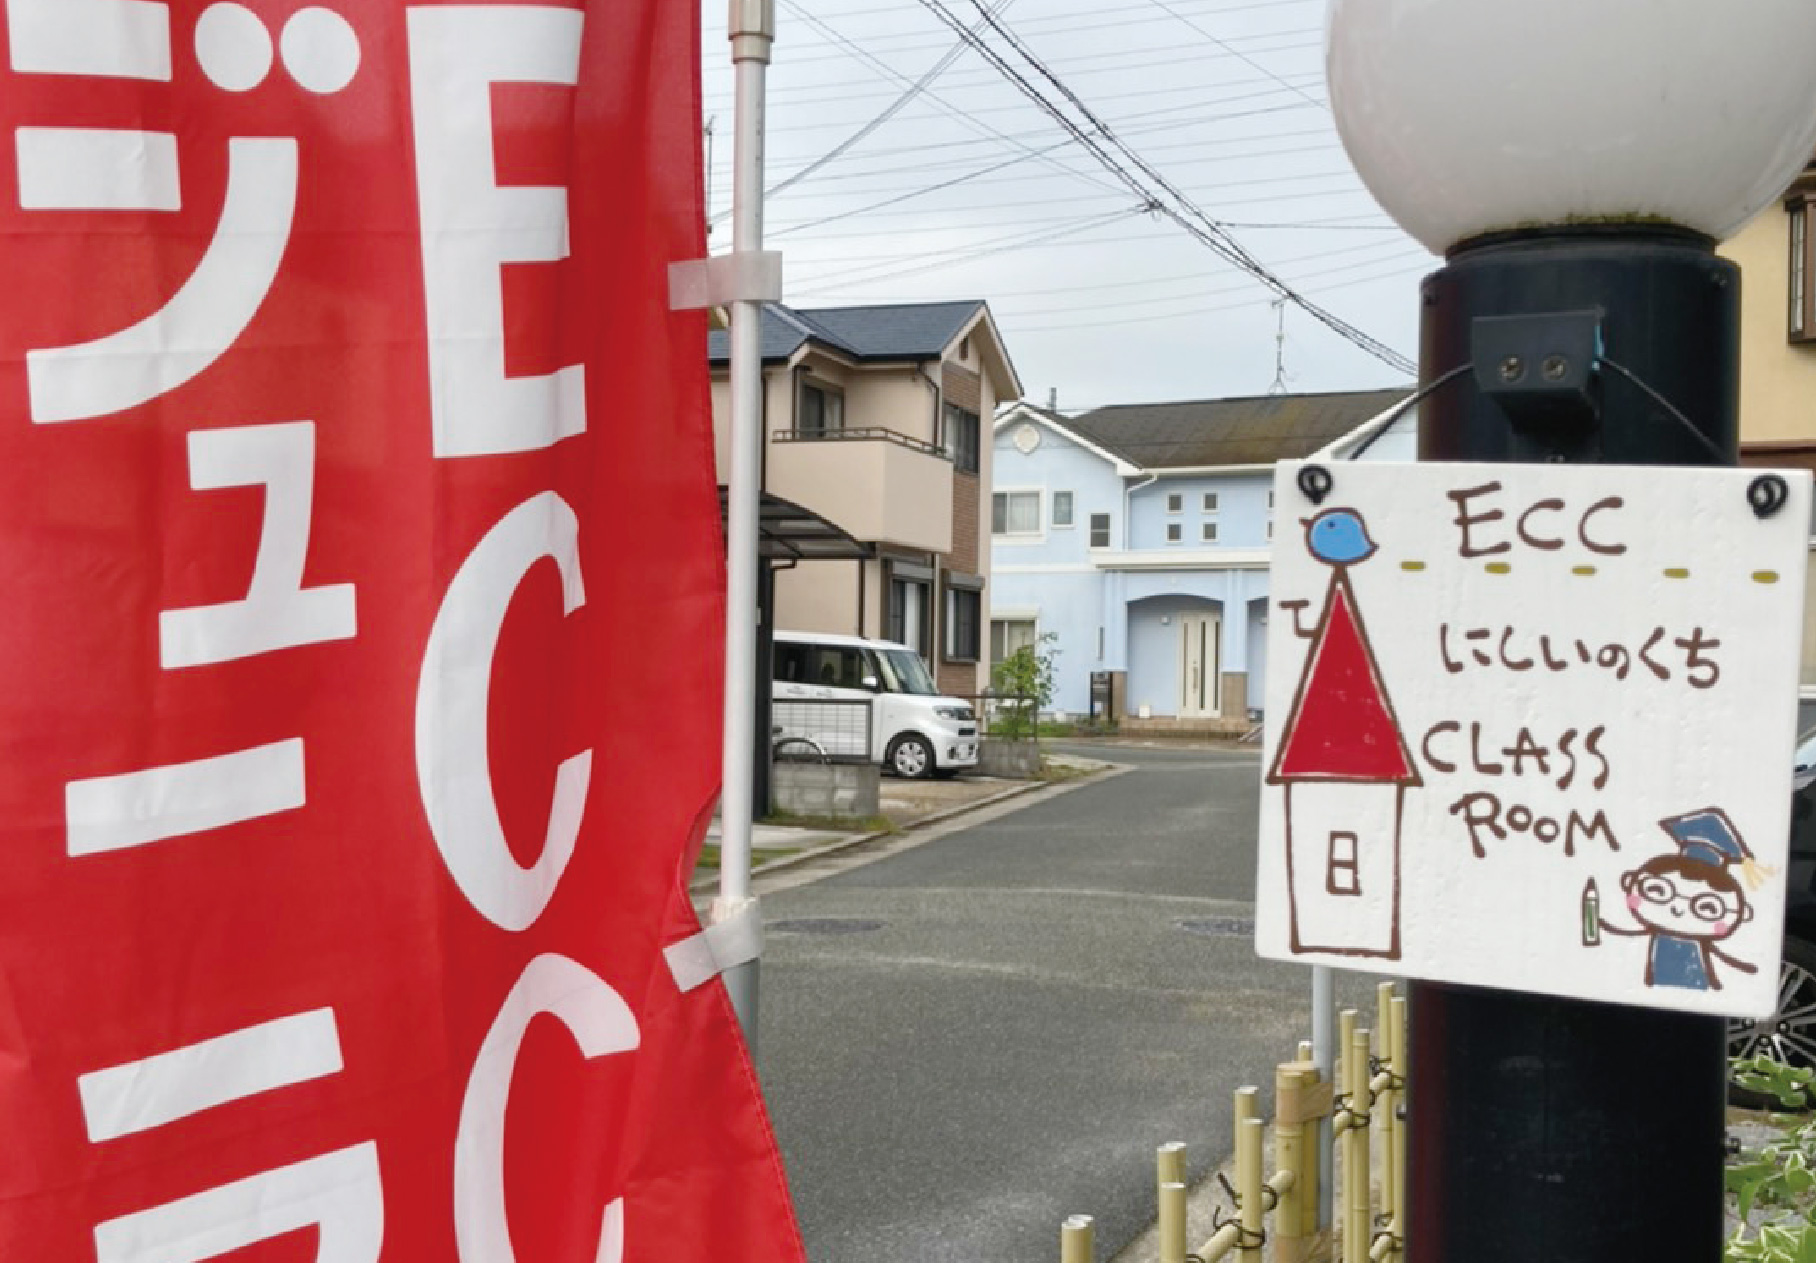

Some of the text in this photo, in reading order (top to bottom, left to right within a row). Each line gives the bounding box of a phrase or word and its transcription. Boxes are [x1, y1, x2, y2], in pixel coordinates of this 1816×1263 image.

[1446, 480, 1627, 558] ECC
[406, 4, 641, 1263] ECC
[1440, 624, 1721, 689] にしいのくち
[1422, 720, 1610, 790] CLASS
[1449, 792, 1621, 859] ROOM
